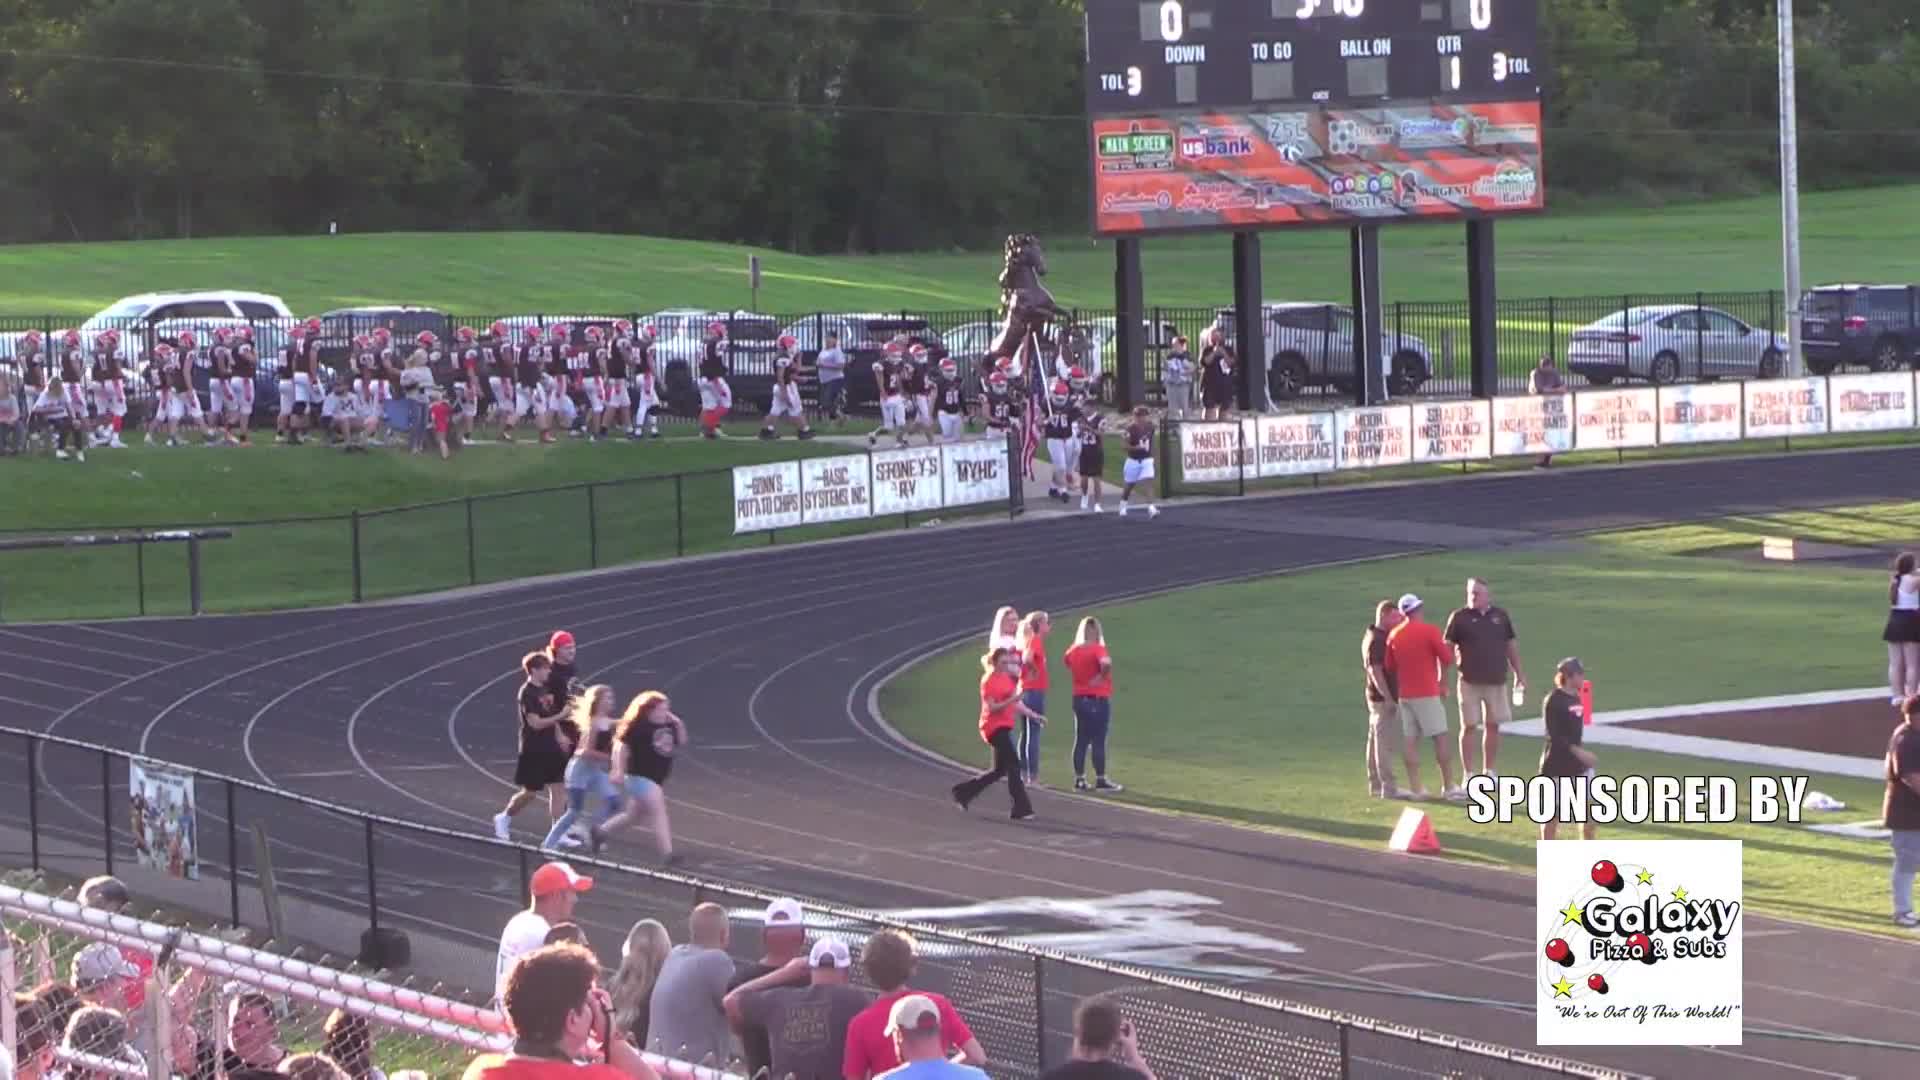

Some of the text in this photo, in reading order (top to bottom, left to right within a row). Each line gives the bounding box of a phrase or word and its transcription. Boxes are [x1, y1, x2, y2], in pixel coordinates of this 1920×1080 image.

[1160, 0, 1183, 41] 0
[1165, 45, 1205, 63] DOWN
[1252, 42, 1292, 60] TO GO
[1340, 38, 1391, 57] BALL ON
[1437, 36, 1462, 53] QTR
[1451, 55, 1460, 89] 1
[1492, 52, 1507, 81] 3
[1508, 58, 1529, 74] TOL
[1101, 75, 1124, 90] TOL
[1127, 66, 1142, 96] 3
[1105, 135, 1167, 153] MAIN SCREEN
[1192, 431, 1235, 449] VARSITY
[1344, 427, 1402, 444] BROTHERS
[1428, 439, 1473, 456] AGENCY
[823, 466, 849, 487] BASIC
[876, 457, 938, 481] STONEY'S
[898, 479, 916, 498] RV
[773, 493, 799, 513] CHIPS
[804, 487, 848, 510] SYSTEMS
